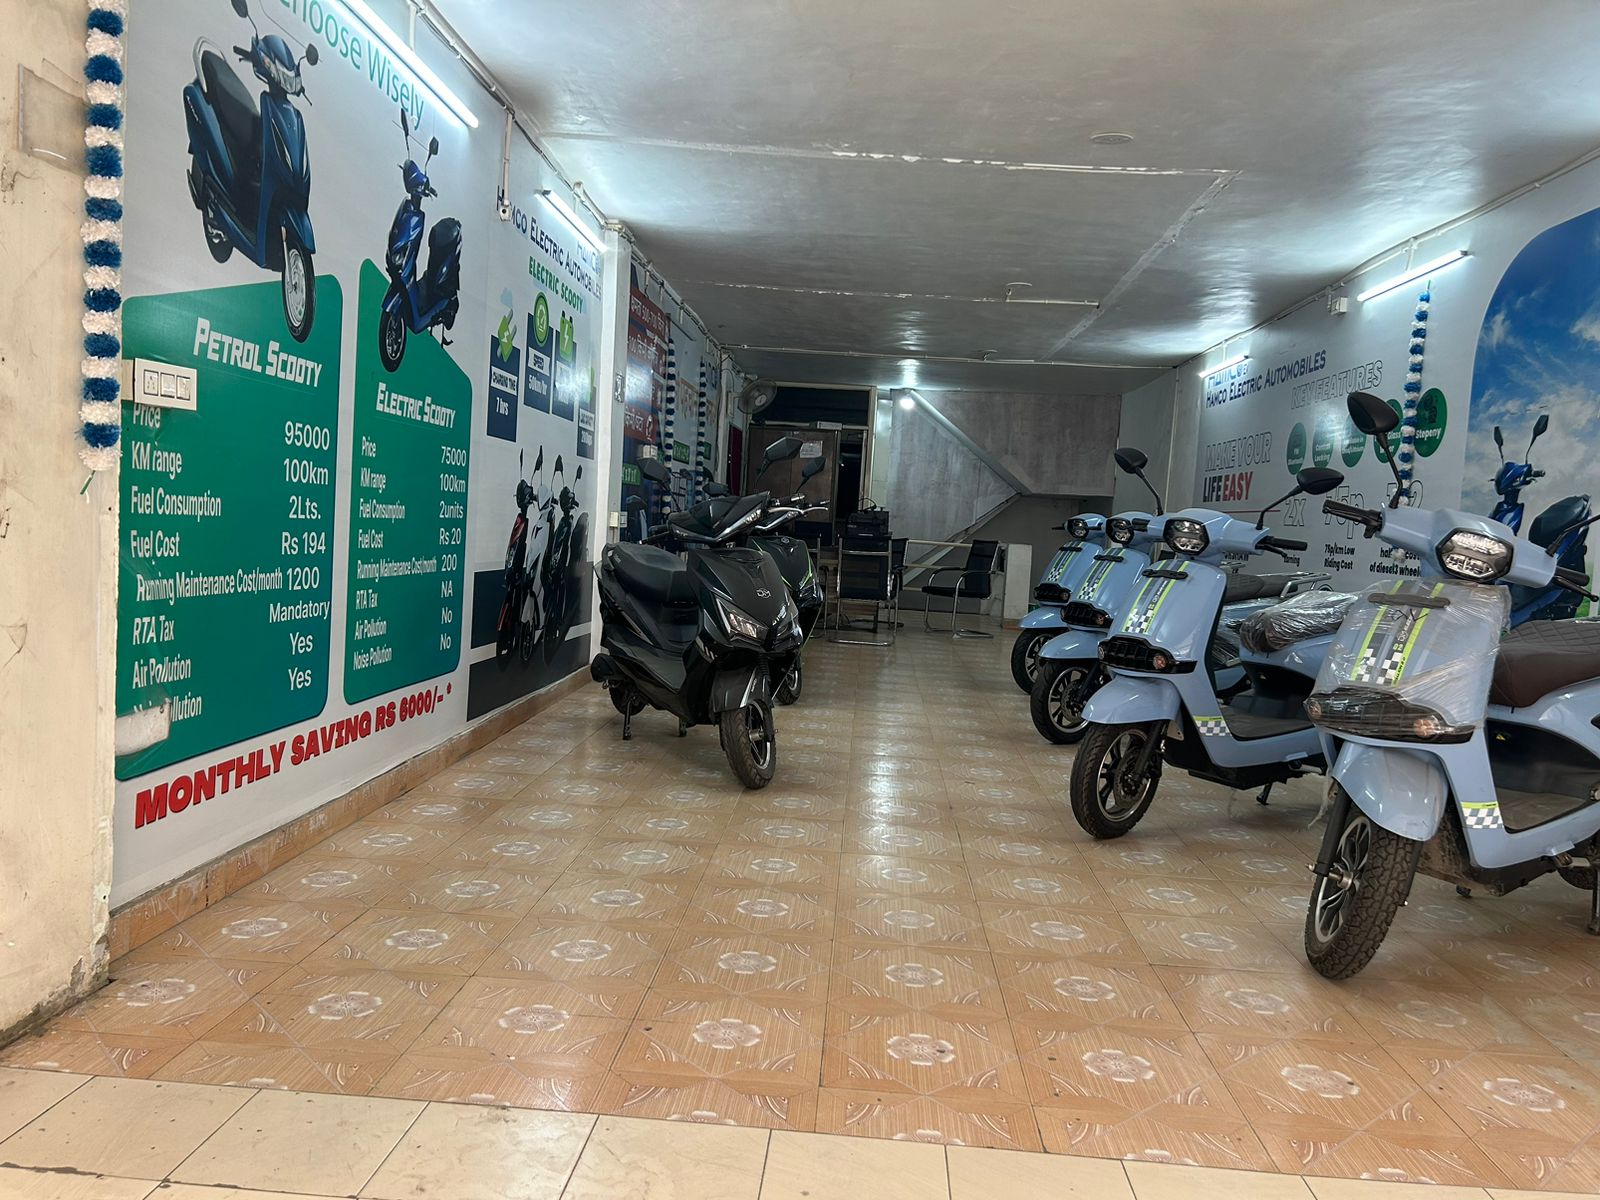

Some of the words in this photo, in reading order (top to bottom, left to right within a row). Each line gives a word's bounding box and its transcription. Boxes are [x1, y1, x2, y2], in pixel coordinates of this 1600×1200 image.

[279, 0, 362, 70] hoose
[367, 39, 424, 131] Wisely
[530, 216, 563, 266] ELECTRIC
[529, 256, 559, 294] ELECTRIC
[561, 282, 584, 314] SCOOTY
[193, 317, 262, 373] PETROL
[265, 341, 322, 388] SCOOTY
[1229, 375, 1262, 401] ELECTRIC
[1264, 350, 1326, 389] AUTOMOBILES
[1316, 361, 1383, 403] FEATURES
[376, 383, 422, 421] ELECTRIC
[423, 396, 456, 429] SCOOTY
[133, 403, 160, 428] Price
[285, 421, 330, 451] 95000
[132, 441, 151, 470] KM
[152, 448, 182, 480] range
[283, 459, 329, 485] 100km
[361, 436, 376, 457] Price
[441, 446, 466, 467] 75000
[1205, 439, 1237, 472] MAKE
[1238, 432, 1272, 467] YOUR
[361, 467, 370, 487] KM
[371, 473, 386, 493] range
[440, 473, 465, 492] 100km
[1203, 475, 1222, 502] LIFE
[1222, 471, 1253, 501] EASY
[131, 486, 154, 514] Fuel
[155, 489, 221, 522] Consumption
[289, 496, 321, 519] 2Lts.
[360, 498, 371, 518] Fuel
[372, 499, 405, 523] Consumption
[440, 501, 463, 518] 2units
[131, 530, 154, 558] Fuel
[155, 533, 180, 558] Cost
[282, 532, 298, 555] Rs
[303, 532, 325, 554] 194
[358, 529, 370, 548] Fuel
[371, 529, 383, 548] Cost
[439, 528, 449, 545] Rs
[451, 528, 461, 544] 20
[1344, 545, 1356, 555] Low
[357, 559, 379, 582] Running
[380, 558, 411, 577] Maintenance
[441, 554, 457, 571] 200
[1324, 557, 1340, 571] Riding
[1341, 560, 1353, 570] Cost
[1369, 562, 1376, 573] of
[1376, 562, 1394, 575] diesel
[136, 572, 174, 606] Running
[176, 570, 234, 598] Maintenance
[237, 567, 283, 594] Cost/month
[287, 567, 319, 591] 1200
[356, 590, 367, 609] RTA
[368, 589, 378, 608] Tax
[441, 580, 453, 598] NA
[133, 617, 156, 645] RTA
[160, 615, 174, 642] Tax
[269, 601, 330, 623] Mandatory
[354, 620, 364, 640] Air
[364, 617, 387, 638] Pollution
[441, 607, 453, 624] No
[290, 632, 313, 655] Yes
[353, 650, 369, 670] Noise
[370, 644, 392, 666] Pollution
[440, 633, 452, 650] No
[132, 659, 148, 689] Air
[149, 653, 191, 685] Pollution
[288, 668, 312, 691] Yes
[171, 691, 202, 722] llution
[135, 741, 286, 829] MONTHLY
[291, 711, 370, 766] SAVING
[375, 704, 396, 732] RS
